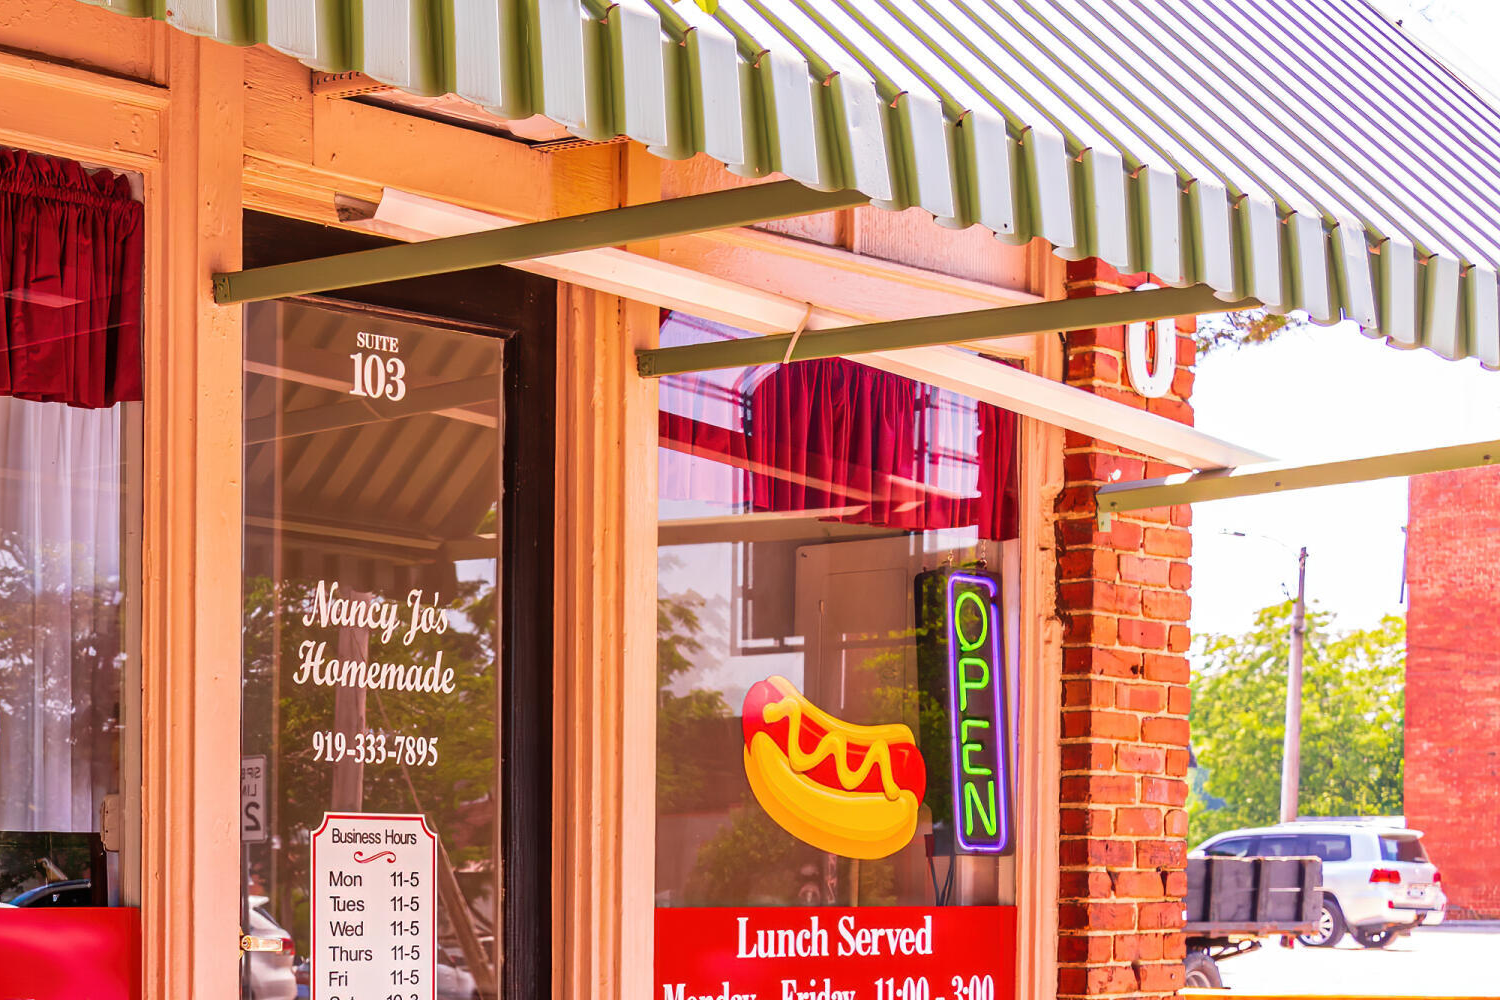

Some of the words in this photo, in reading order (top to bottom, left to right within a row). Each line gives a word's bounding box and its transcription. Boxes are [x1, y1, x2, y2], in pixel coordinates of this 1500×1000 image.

[356, 331, 399, 353] SUITE
[349, 352, 406, 401] 103
[302, 580, 400, 644] Nancy
[403, 589, 448, 646] Jo's
[293, 640, 456, 694] Homemade
[954, 591, 998, 837] OPEN
[312, 731, 439, 767] 919-333-7895
[332, 828, 382, 844] Business
[385, 829, 417, 845] Hours
[329, 871, 362, 887] Mon
[390, 872, 420, 887] 11-5
[329, 896, 365, 912] Tues
[390, 896, 420, 912] 11-5
[329, 921, 364, 937] Wed
[390, 921, 420, 936] 11-5
[736, 916, 829, 959] Lunch
[837, 915, 933, 956] Served
[328, 946, 373, 962] Thurs
[391, 945, 420, 961] 11-5
[329, 971, 348, 987] Fri
[390, 970, 420, 985] 11-5
